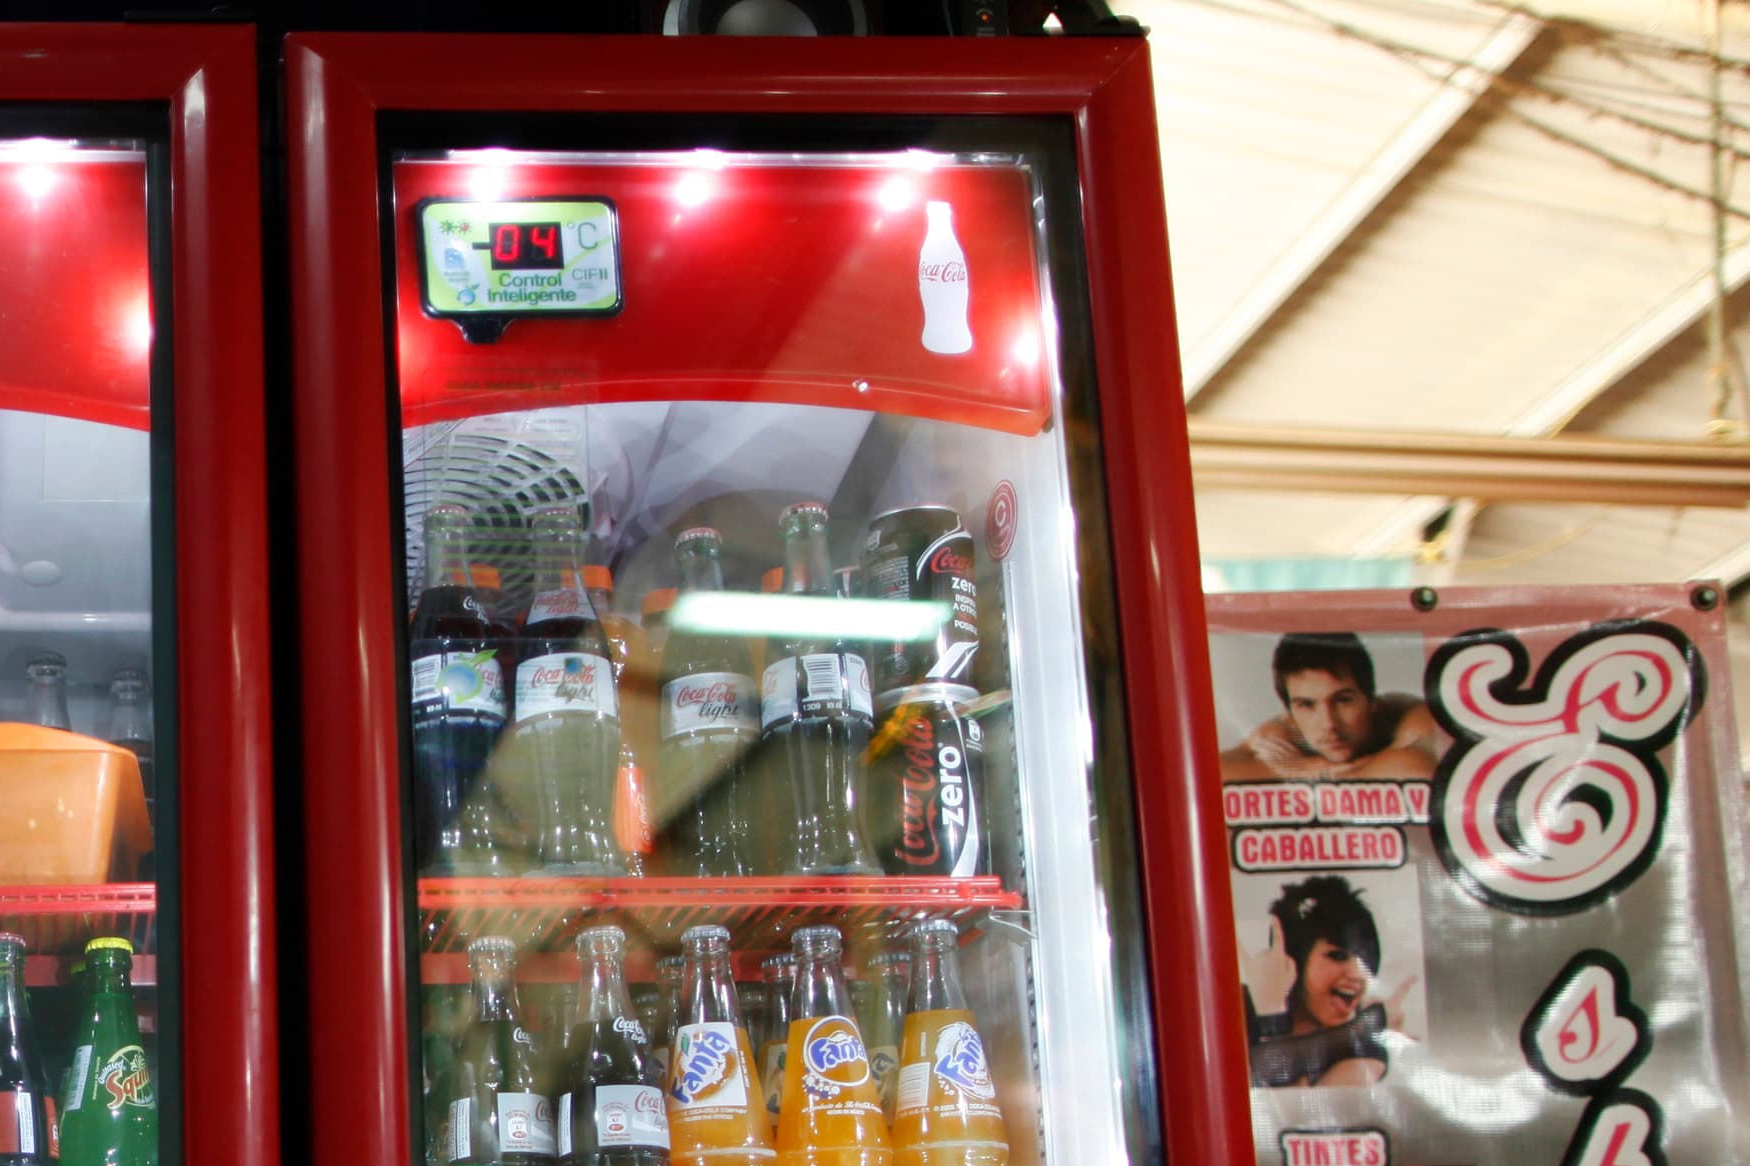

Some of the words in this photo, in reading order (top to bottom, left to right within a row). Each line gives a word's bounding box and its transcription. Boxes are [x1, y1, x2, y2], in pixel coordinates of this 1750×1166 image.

[499, 272, 562, 287] Control
[488, 286, 576, 305] Inteligente
[677, 683, 736, 708] Coca-Cola
[698, 701, 738, 722] light
[938, 745, 964, 826] zero
[1225, 789, 1310, 820] ORTES
[1321, 788, 1401, 816] DAMA
[1409, 788, 1424, 815] Y
[1242, 833, 1397, 863] CABALLERO
[672, 1031, 731, 1104] Fanta
[808, 1037, 867, 1072] Fanta
[1288, 1138, 1380, 1166] TINTES
